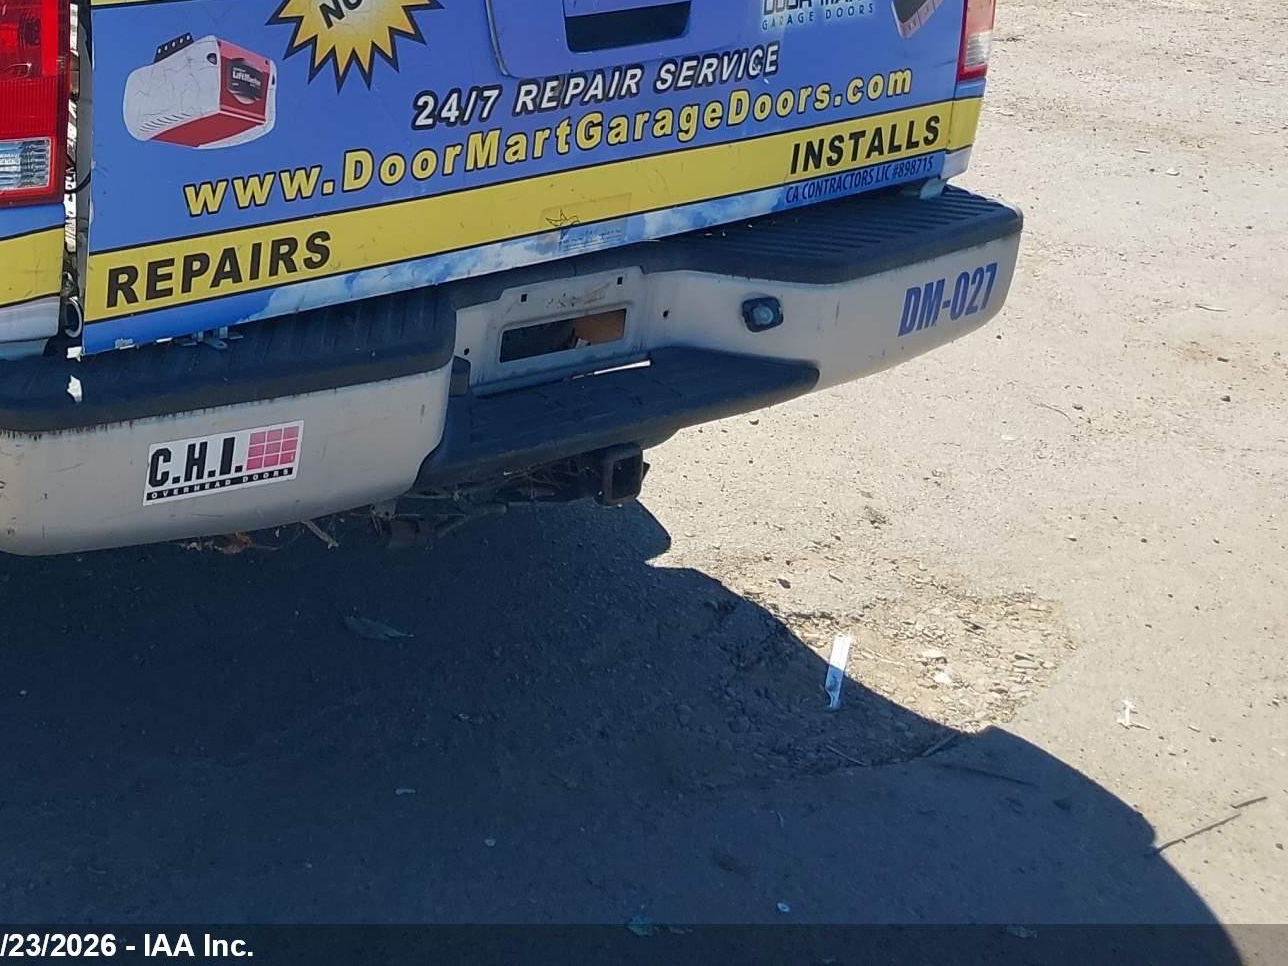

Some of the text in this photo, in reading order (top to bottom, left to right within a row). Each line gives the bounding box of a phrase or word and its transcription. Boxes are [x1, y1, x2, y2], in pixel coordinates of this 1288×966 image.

[762, 2, 874, 31] GARAGE DOORS
[413, 42, 780, 131] 24/7 REPAIR SERVICE
[183, 67, 913, 216] www.DoorMartGarageDoors.com
[790, 115, 940, 175] INSTALLS
[785, 154, 934, 204] CA CONTRACTORS LIC #898715
[105, 230, 332, 308] REPAIRS
[898, 262, 998, 337] DM-027
[148, 436, 243, 488] C.H.I.
[151, 468, 289, 500] OVERHEAD DOORS
